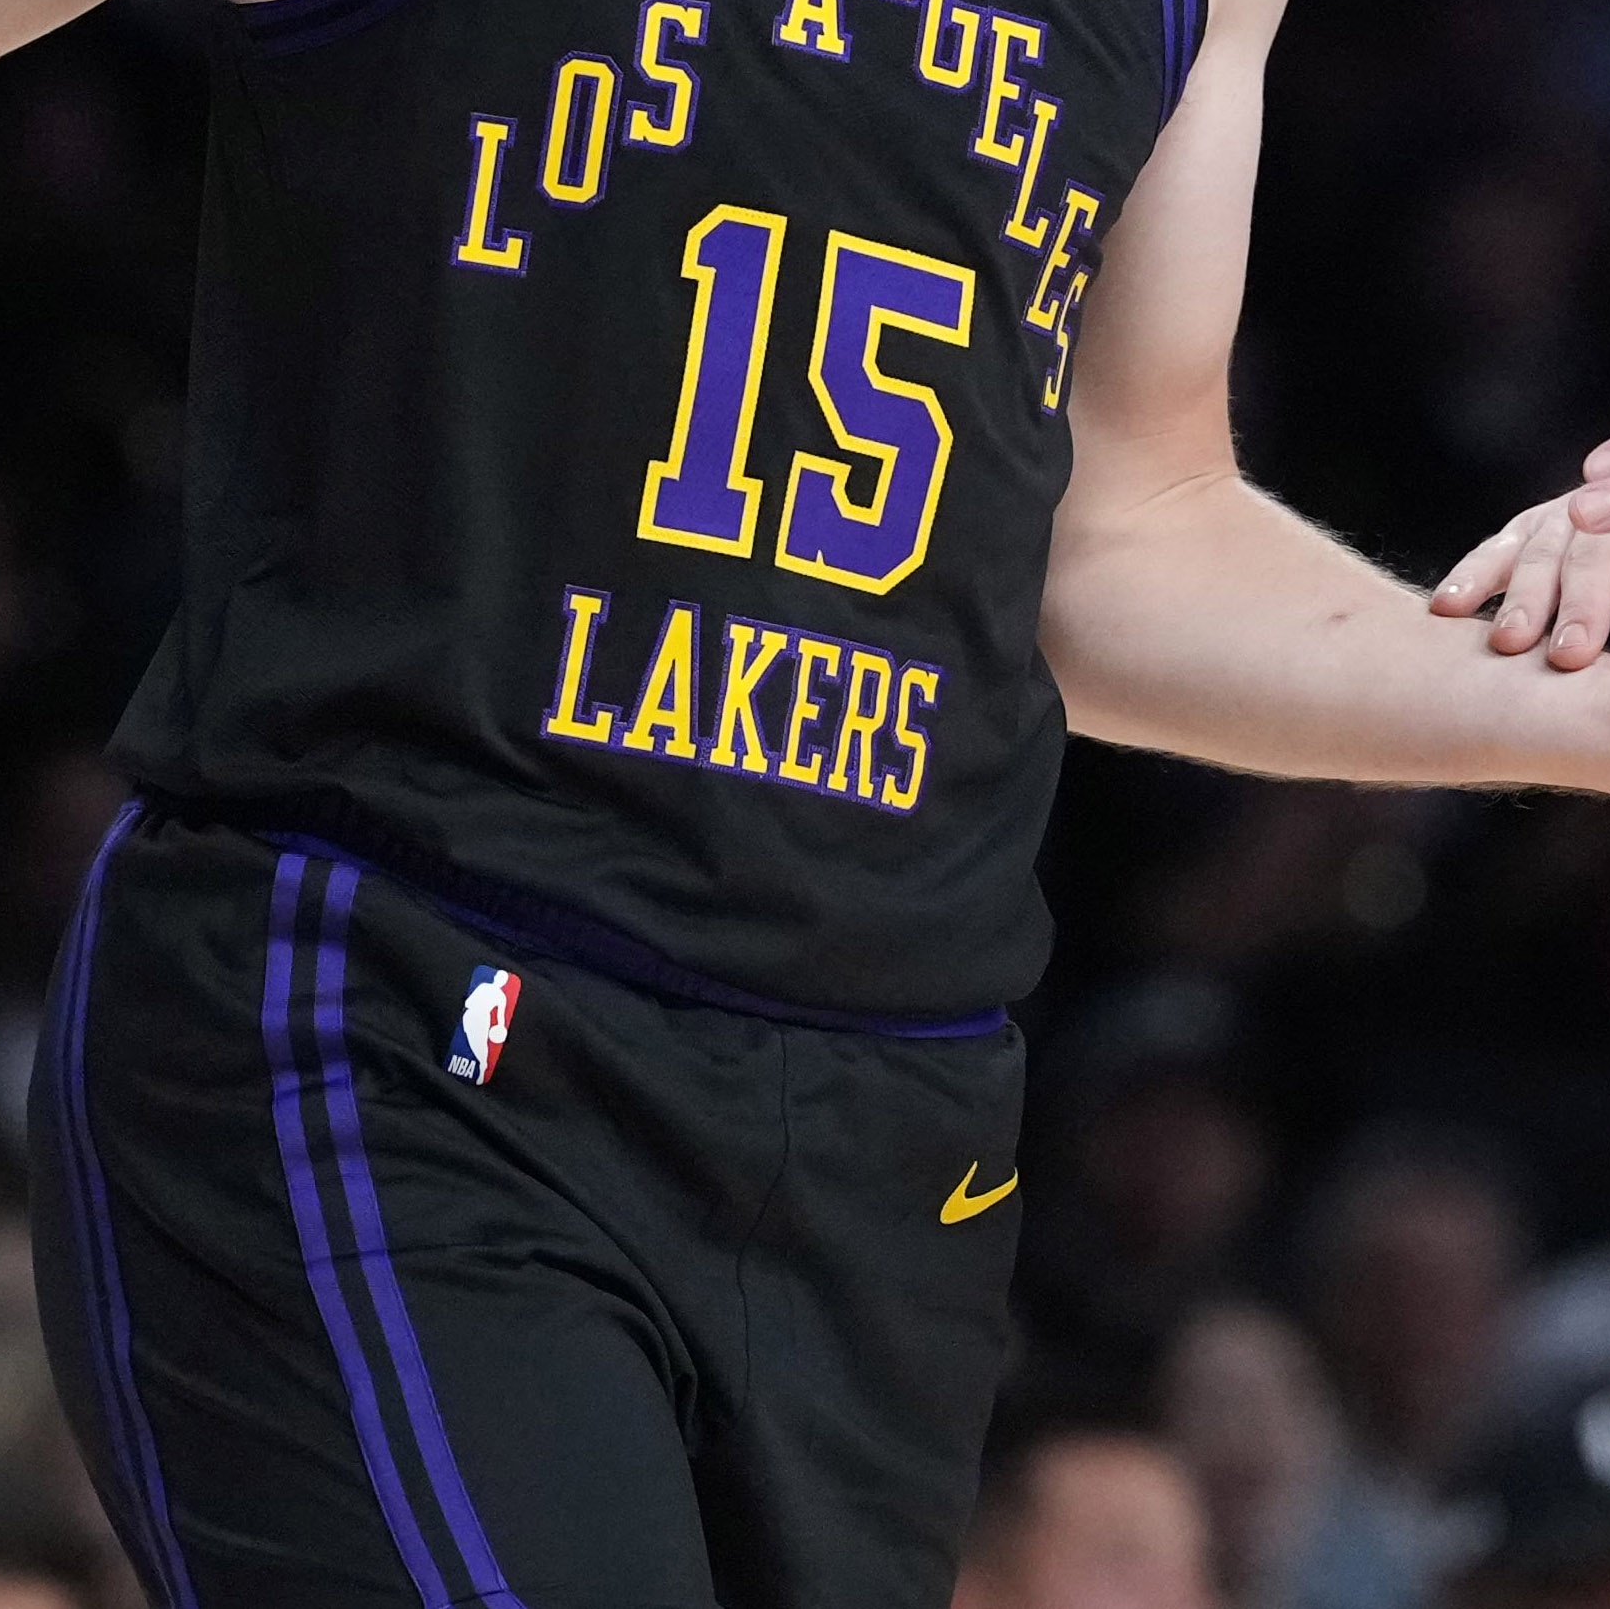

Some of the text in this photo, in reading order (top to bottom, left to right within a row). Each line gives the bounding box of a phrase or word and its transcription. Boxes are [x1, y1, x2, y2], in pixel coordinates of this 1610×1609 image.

[636, 203, 977, 596] 15
[545, 589, 943, 814] LAKERS
[447, 1054, 477, 1079] NBA
